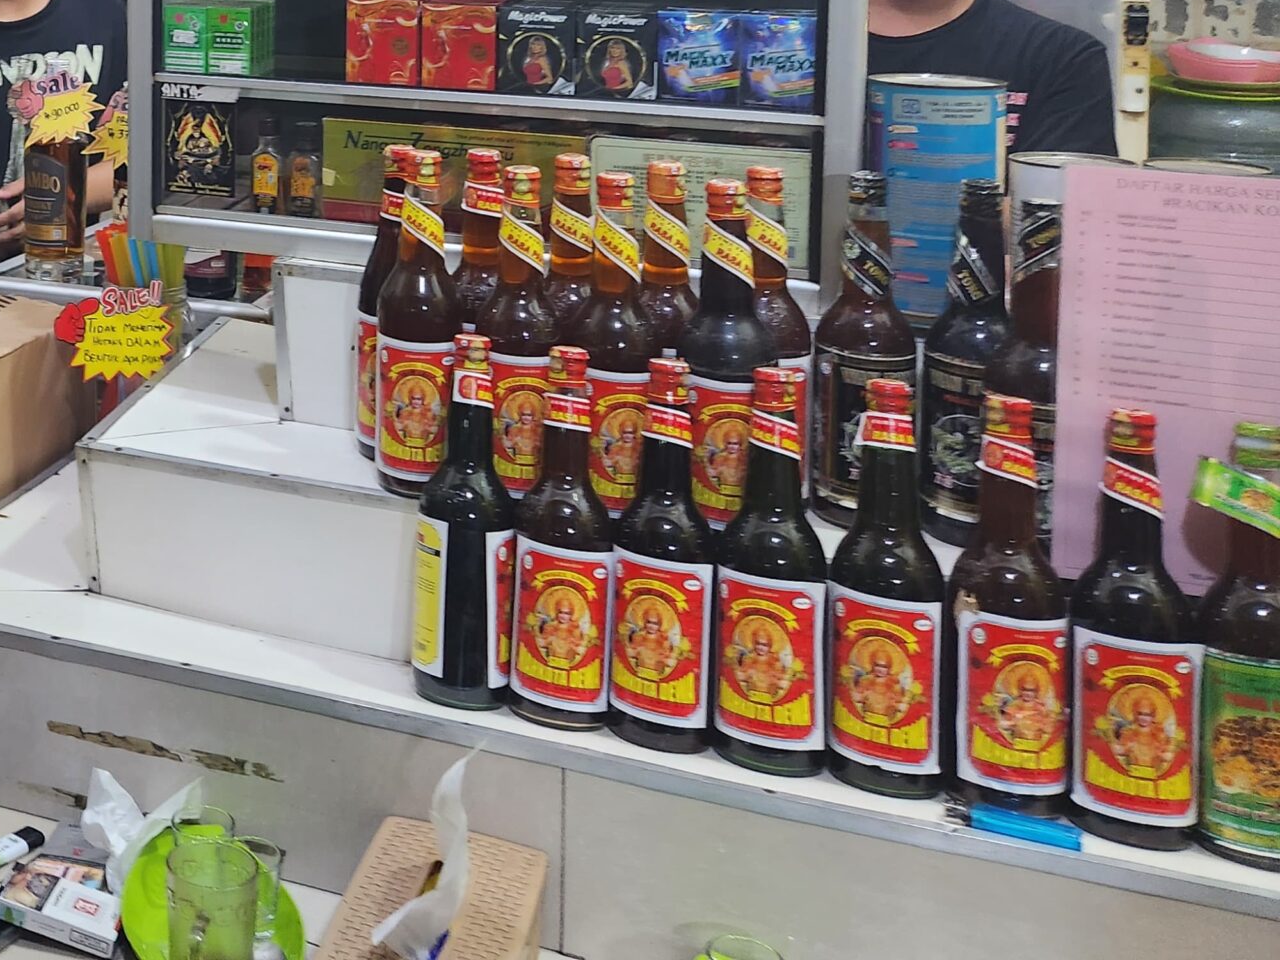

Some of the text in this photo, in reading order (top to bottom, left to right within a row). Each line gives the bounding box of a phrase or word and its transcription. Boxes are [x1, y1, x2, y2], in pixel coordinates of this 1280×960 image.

[507, 10, 568, 24] MagicPower
[585, 14, 648, 28] MagicPower
[689, 55, 728, 70] MAXX
[37, 72, 81, 95] sale
[1117, 178, 1184, 193] DAFTAR
[1190, 184, 1249, 199] HARGA
